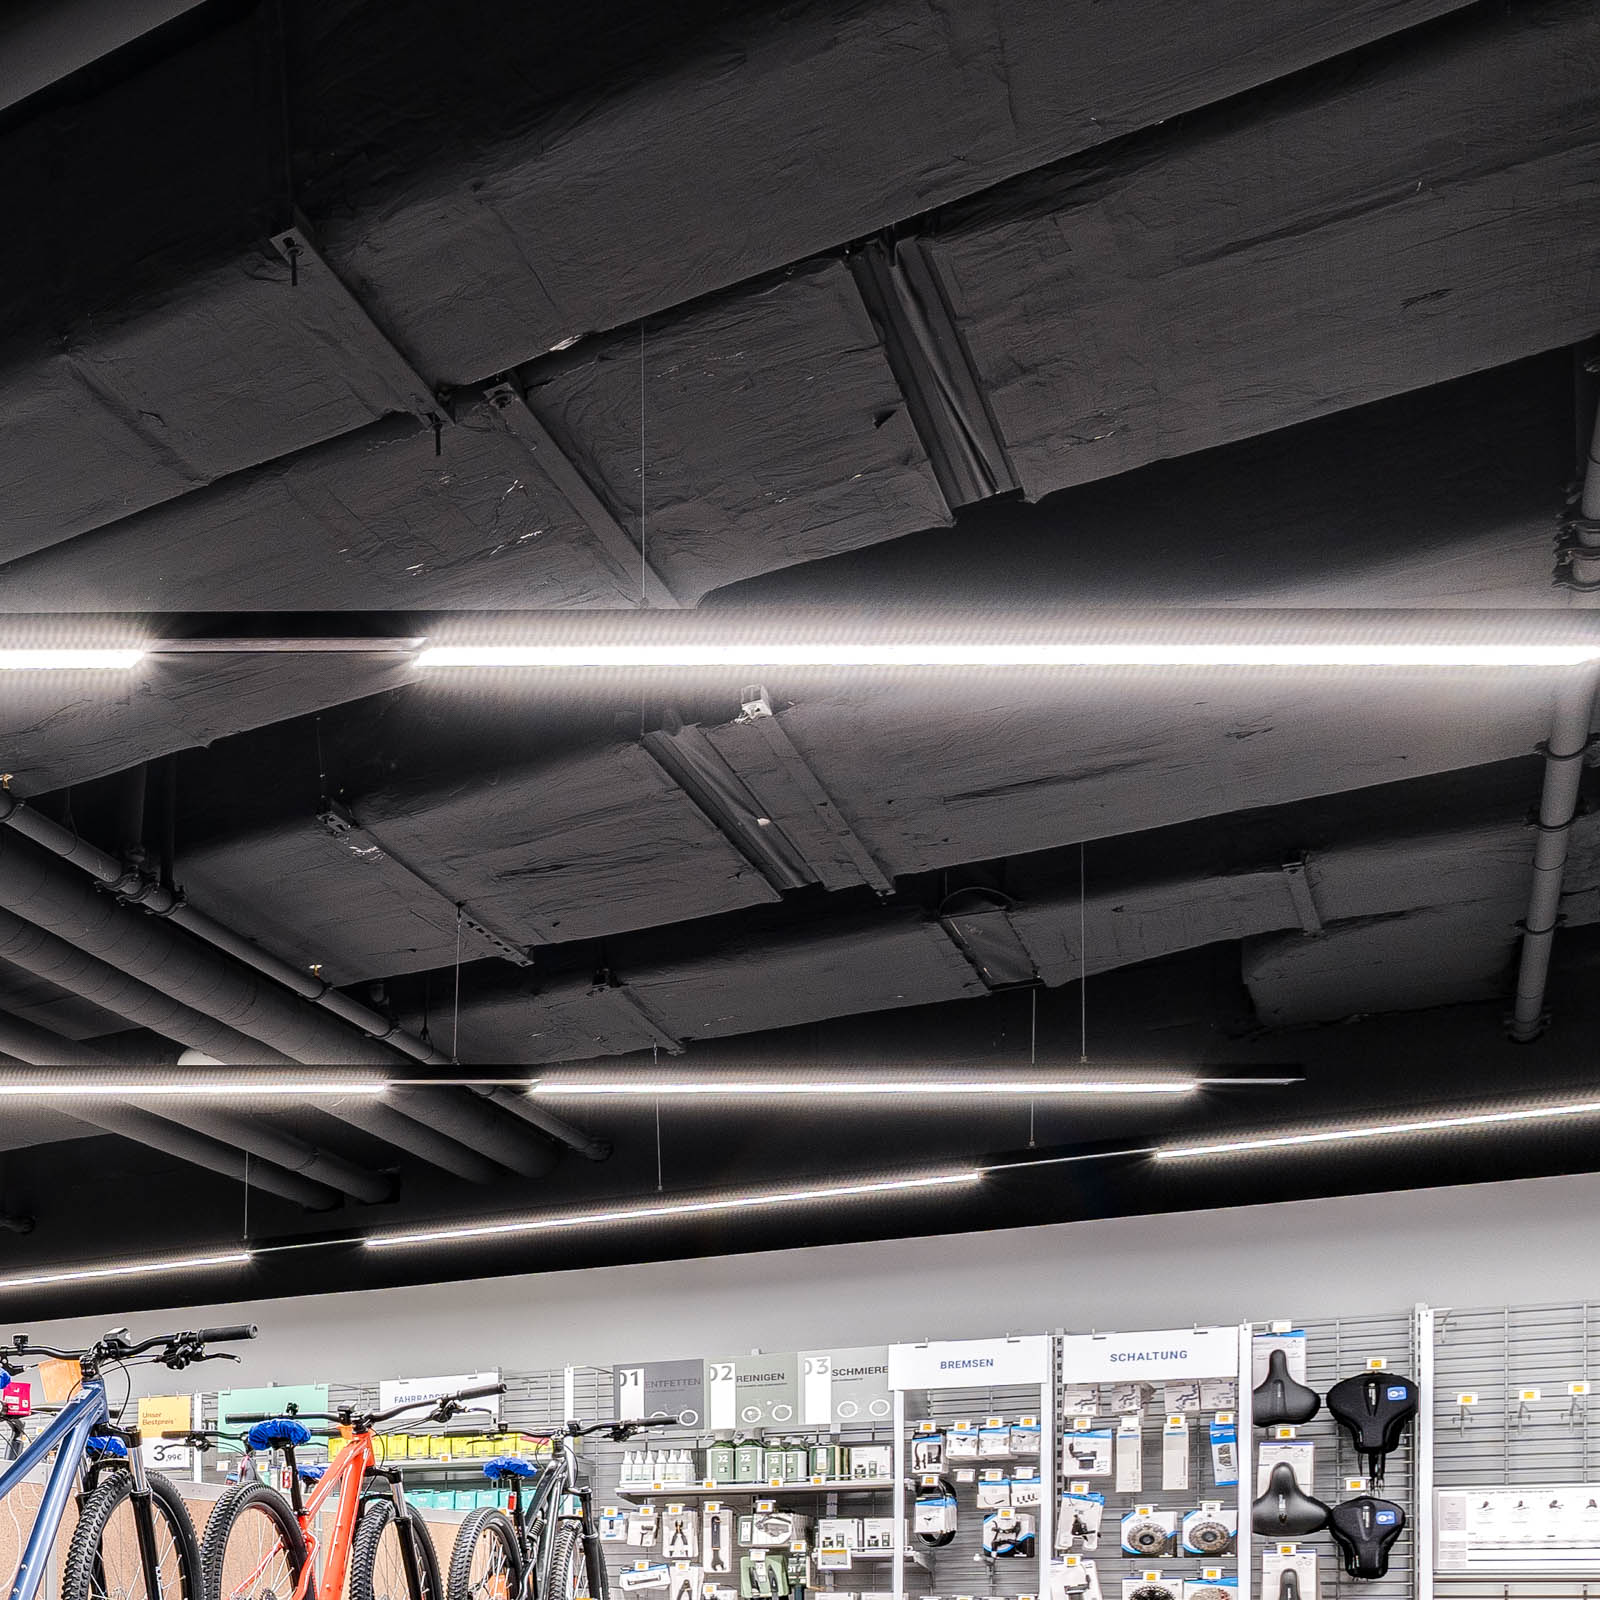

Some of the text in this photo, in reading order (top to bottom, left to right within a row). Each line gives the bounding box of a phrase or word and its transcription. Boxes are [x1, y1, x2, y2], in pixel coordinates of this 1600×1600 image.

[1110, 1350, 1188, 1363] SCHALTUNG
[940, 1358, 994, 1370] BREMSEN
[736, 1372, 785, 1383] REINIGEN
[832, 1366, 889, 1377] SCHMIERE
[645, 1377, 701, 1389] ENTFETTEN
[153, 1445, 183, 1462] 3,99€
